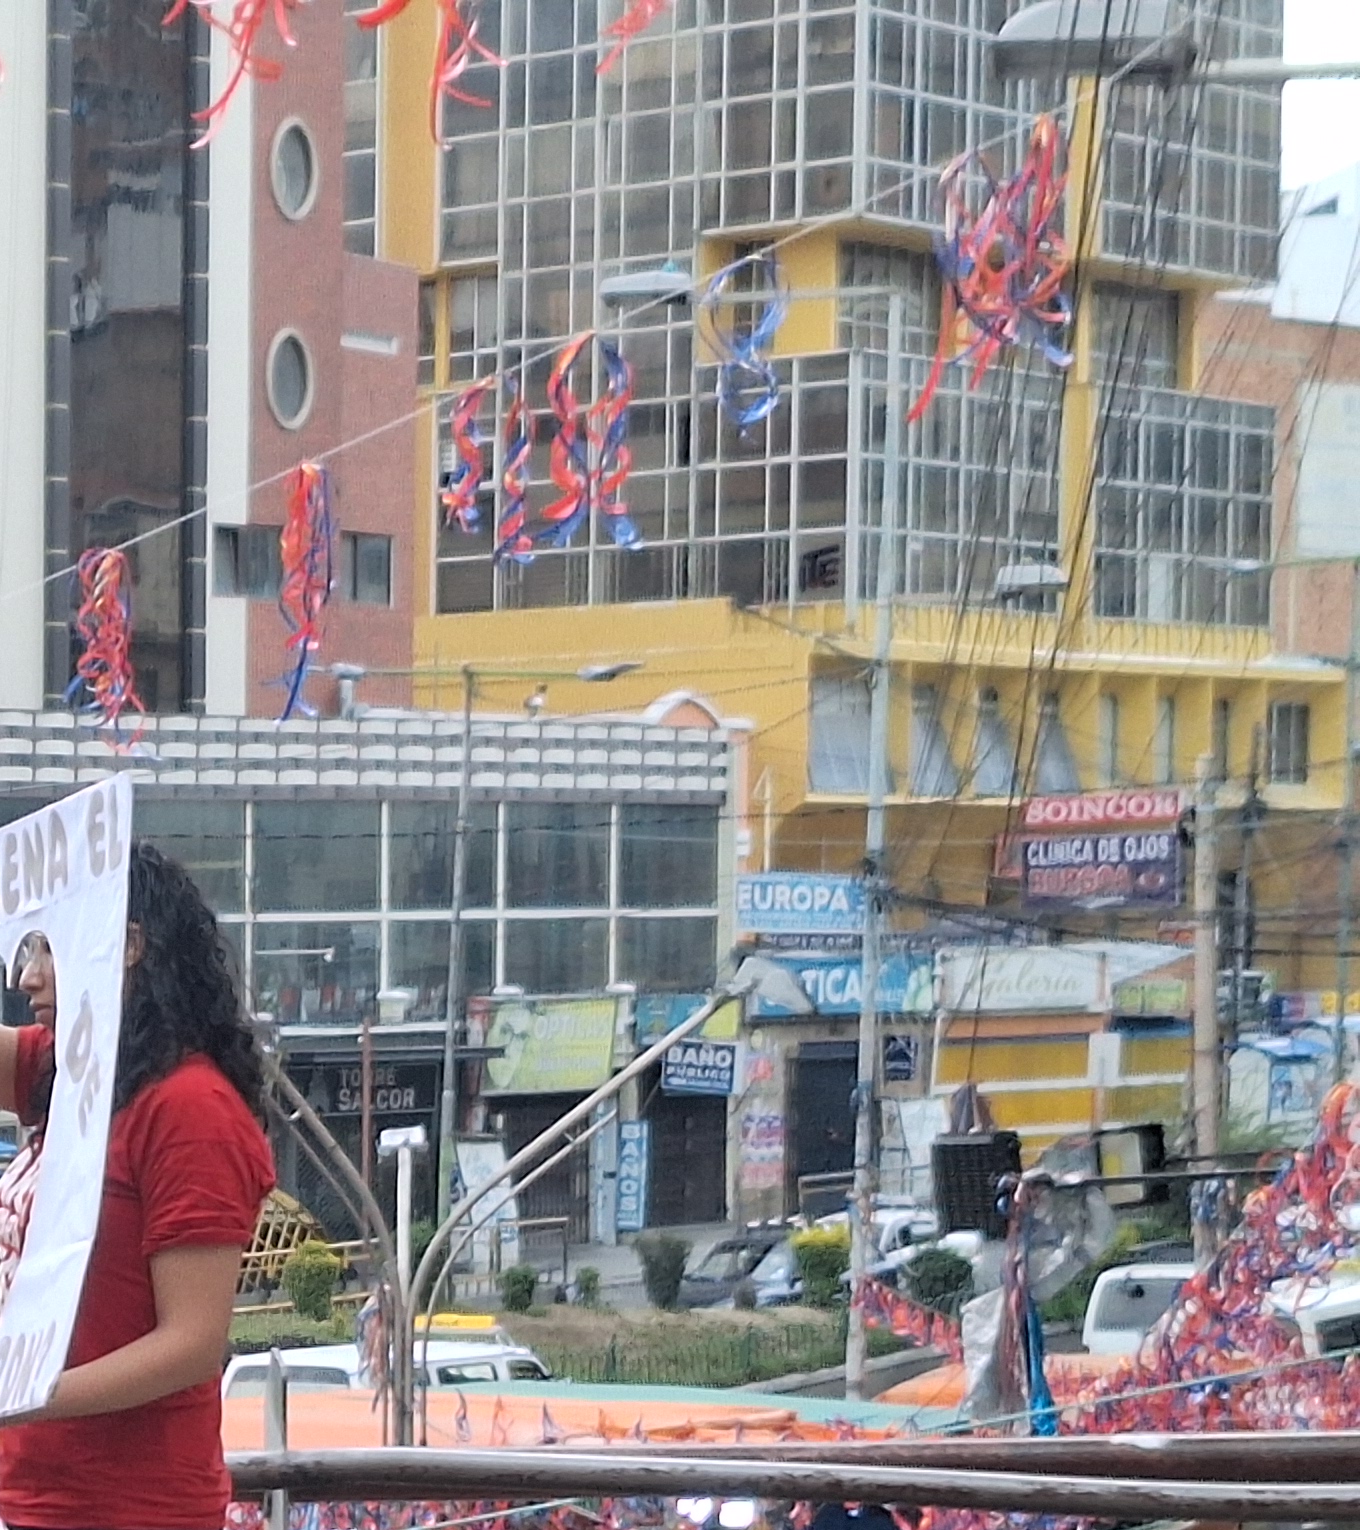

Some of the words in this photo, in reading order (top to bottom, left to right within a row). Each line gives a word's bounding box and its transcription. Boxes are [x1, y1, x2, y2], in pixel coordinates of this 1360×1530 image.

[87, 784, 123, 878] EL
[1097, 839, 1120, 862] DE
[1125, 835, 1169, 861] OJOS
[737, 882, 849, 911] EUROPA
[339, 1067, 398, 1089] TORE
[337, 1086, 415, 1111] SACOR
